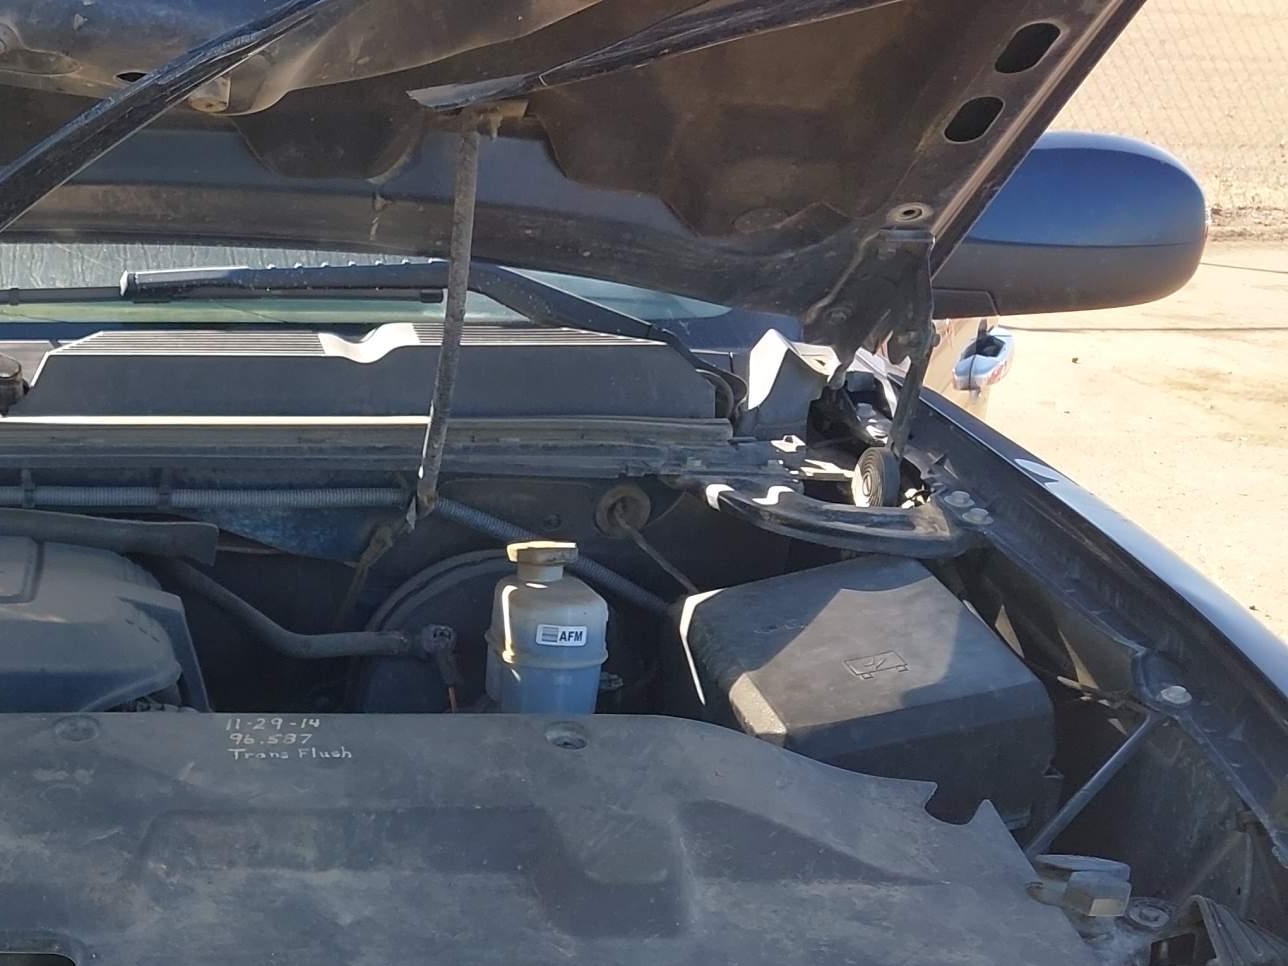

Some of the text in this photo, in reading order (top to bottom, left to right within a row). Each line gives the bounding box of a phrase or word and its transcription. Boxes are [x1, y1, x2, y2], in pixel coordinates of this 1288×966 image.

[559, 630, 583, 642] AFM
[225, 717, 320, 731] 11-29-14
[227, 746, 352, 760] Trans Flush
